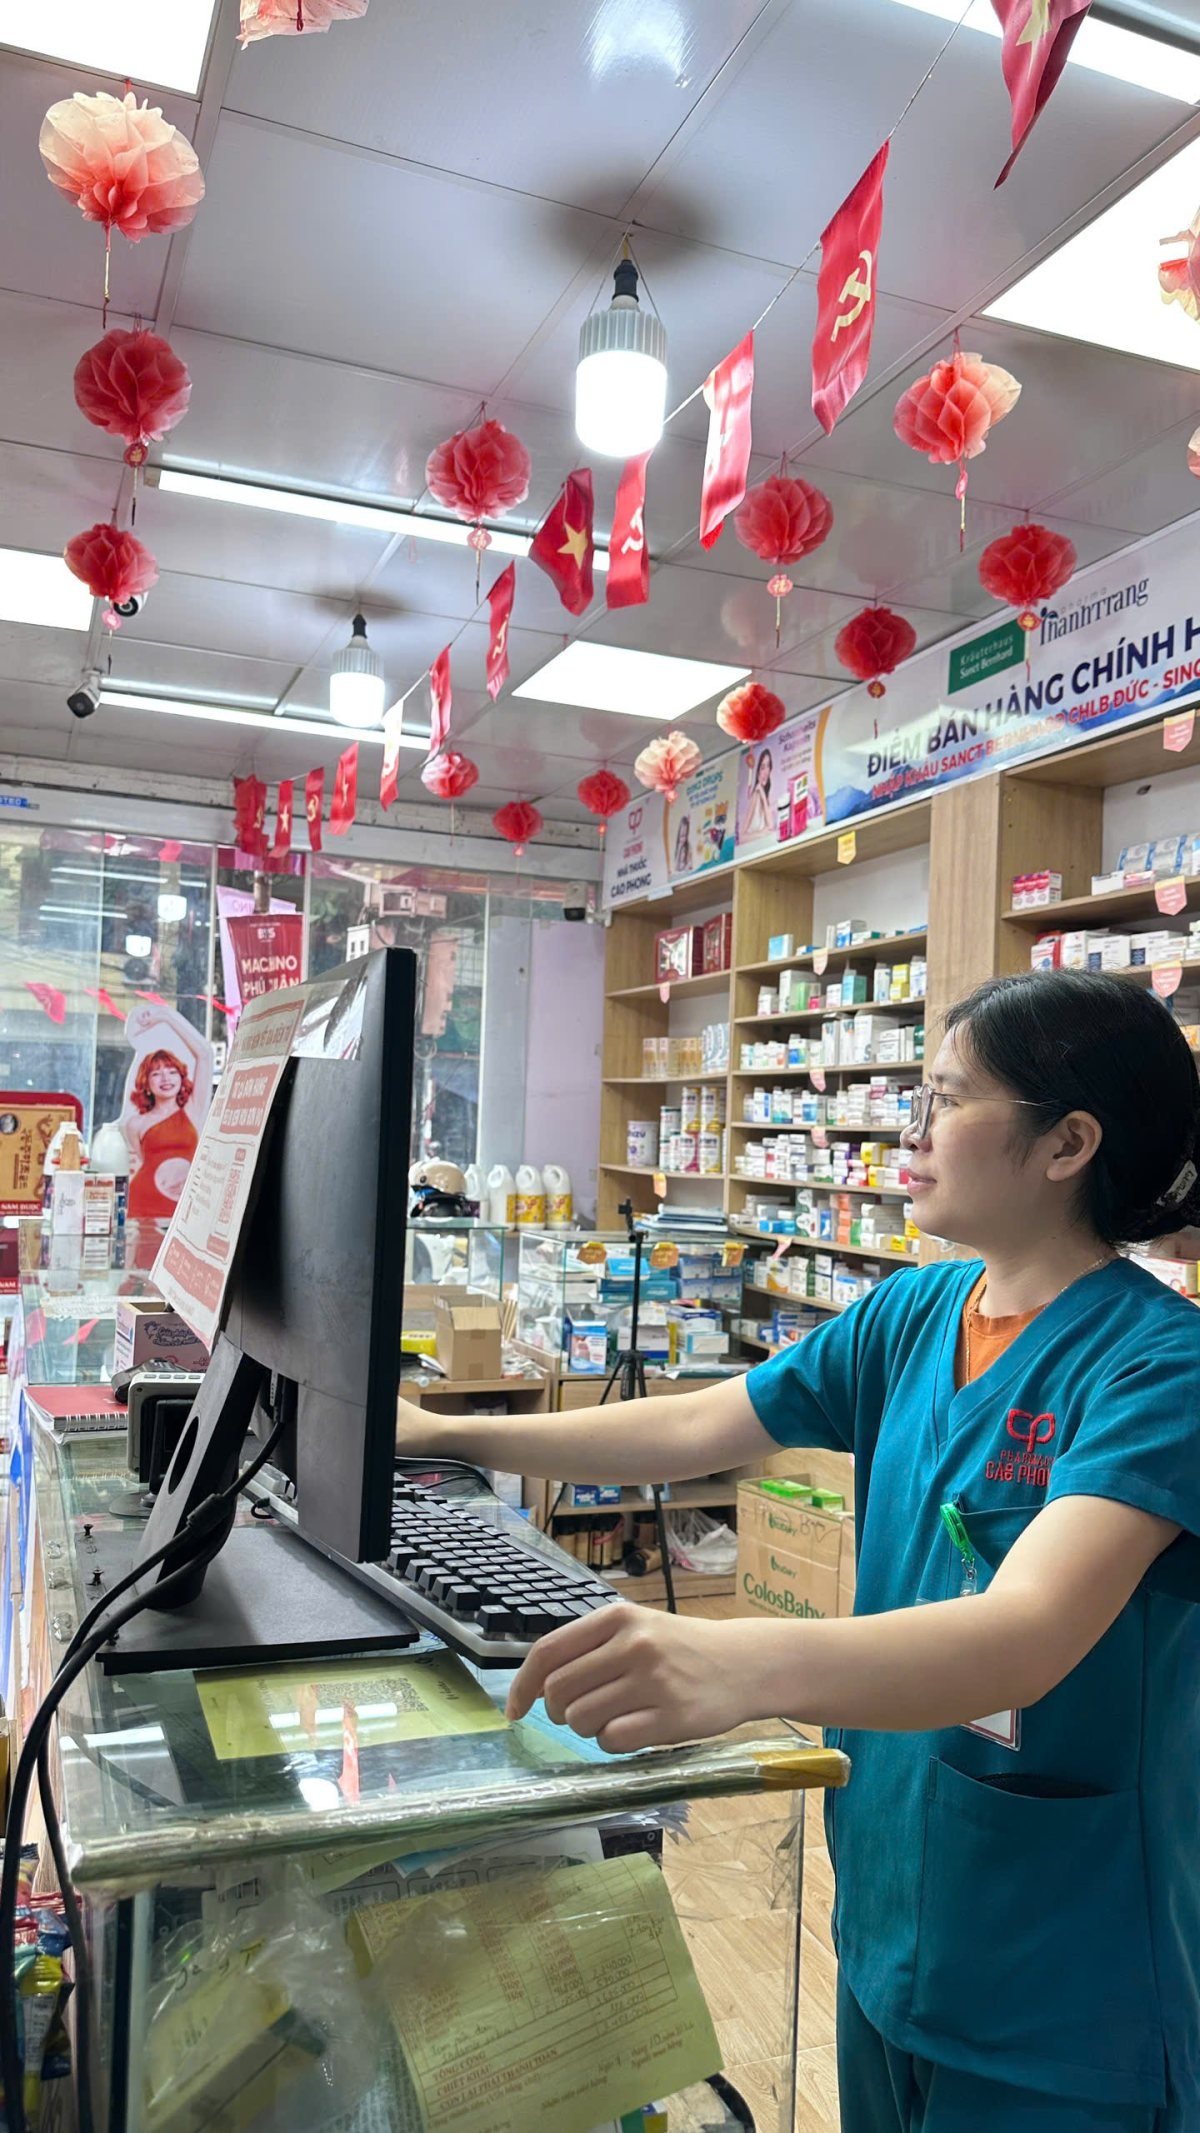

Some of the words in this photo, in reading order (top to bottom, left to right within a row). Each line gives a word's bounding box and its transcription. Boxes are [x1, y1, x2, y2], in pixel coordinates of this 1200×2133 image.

[867, 728, 922, 778] ĐIỂM
[927, 708, 978, 755] BÁN
[984, 672, 1065, 732] HÀNG
[1071, 624, 1175, 695] CHÍNH
[941, 742, 983, 772] SANCT
[1069, 694, 1110, 724] CHLB
[1112, 678, 1150, 709] ĐỨC
[611, 882, 626, 898] CAO
[626, 872, 652, 894] PHONG
[743, 1572, 826, 1618] ColosBaby
